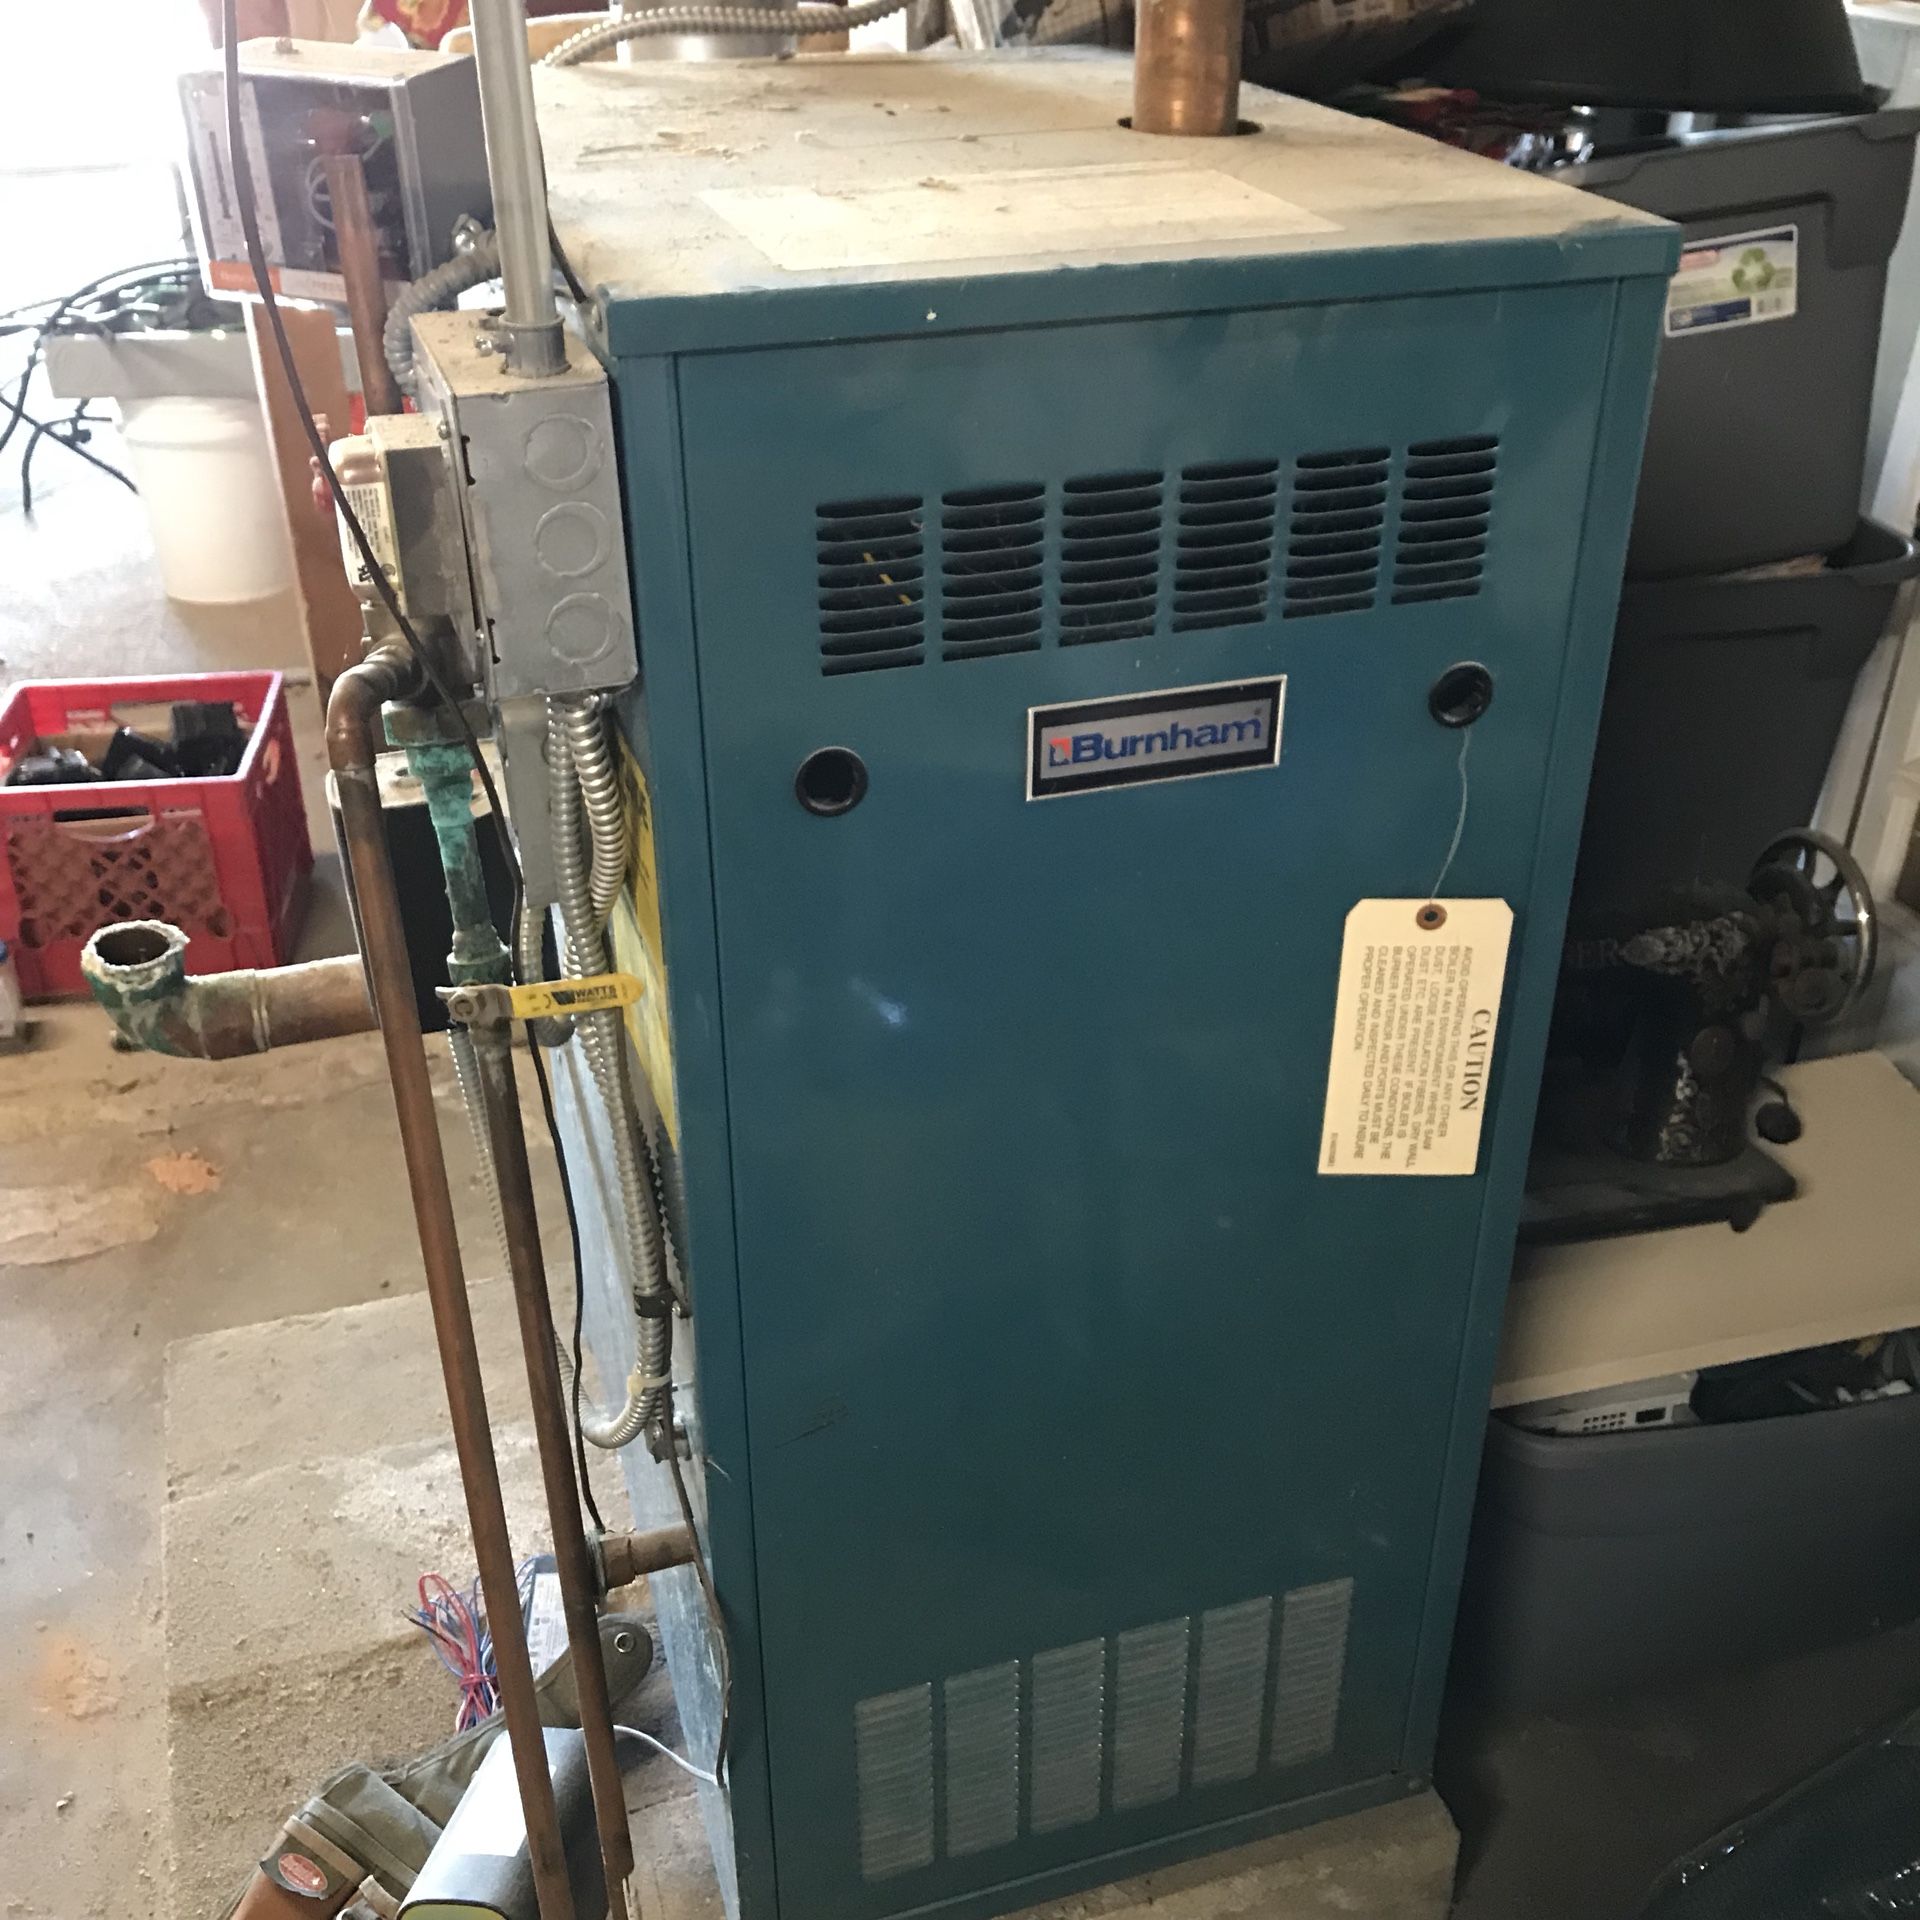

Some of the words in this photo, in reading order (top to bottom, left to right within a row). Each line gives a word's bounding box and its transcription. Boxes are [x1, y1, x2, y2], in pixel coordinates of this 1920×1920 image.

[1072, 716, 1262, 763] Burnham
[1360, 946, 1374, 988] PROPER
[1373, 945, 1389, 994] CLEANED
[1388, 946, 1402, 989] BURNER
[1400, 945, 1417, 1001] OPERATED
[1445, 945, 1460, 982] BOILER
[1459, 946, 1473, 976] AVOID
[576, 985, 618, 998] WATTS
[1426, 981, 1440, 1016] LOOSE
[1441, 999, 1452, 1013] AN
[1443, 987, 1454, 996] IN
[1371, 998, 1382, 1018] AND
[1382, 992, 1397, 1040] INTERIOR
[1396, 1004, 1409, 1039] UNDER
[1411, 1004, 1423, 1024] ARE
[1451, 979, 1469, 1036] OPERATING
[1364, 1022, 1379, 1077] INSPECTED
[1379, 1043, 1390, 1063] AND
[1391, 1043, 1404, 1073] THESE
[1418, 1019, 1435, 1076] INSULATION
[1430, 1016, 1449, 1087] ENVIRONMENT
[1447, 1039, 1459, 1061] THIS
[1461, 1009, 1492, 1110] CAUTION
[1374, 1067, 1387, 1099] PORTS
[1403, 1080, 1413, 1088] IF
[1445, 1064, 1456, 1078] OR
[1360, 1080, 1372, 1105] DAILY
[1442, 1082, 1453, 1100] ANY
[1358, 1110, 1368, 1121] TO
[1371, 1102, 1383, 1128] MUST
[1398, 1092, 1411, 1125] BOILER
[1425, 1091, 1438, 1125] WHERE
[1437, 1103, 1450, 1137] OTHER
[1353, 1124, 1366, 1158] INSURE
[1368, 1131, 1379, 1143] BE
[1397, 1129, 1407, 1138] IS
[1409, 1121, 1421, 1139] DRY
[1422, 1128, 1433, 1149] SAW
[1380, 1141, 1392, 1159] THE
[1405, 1143, 1418, 1167] WALL
